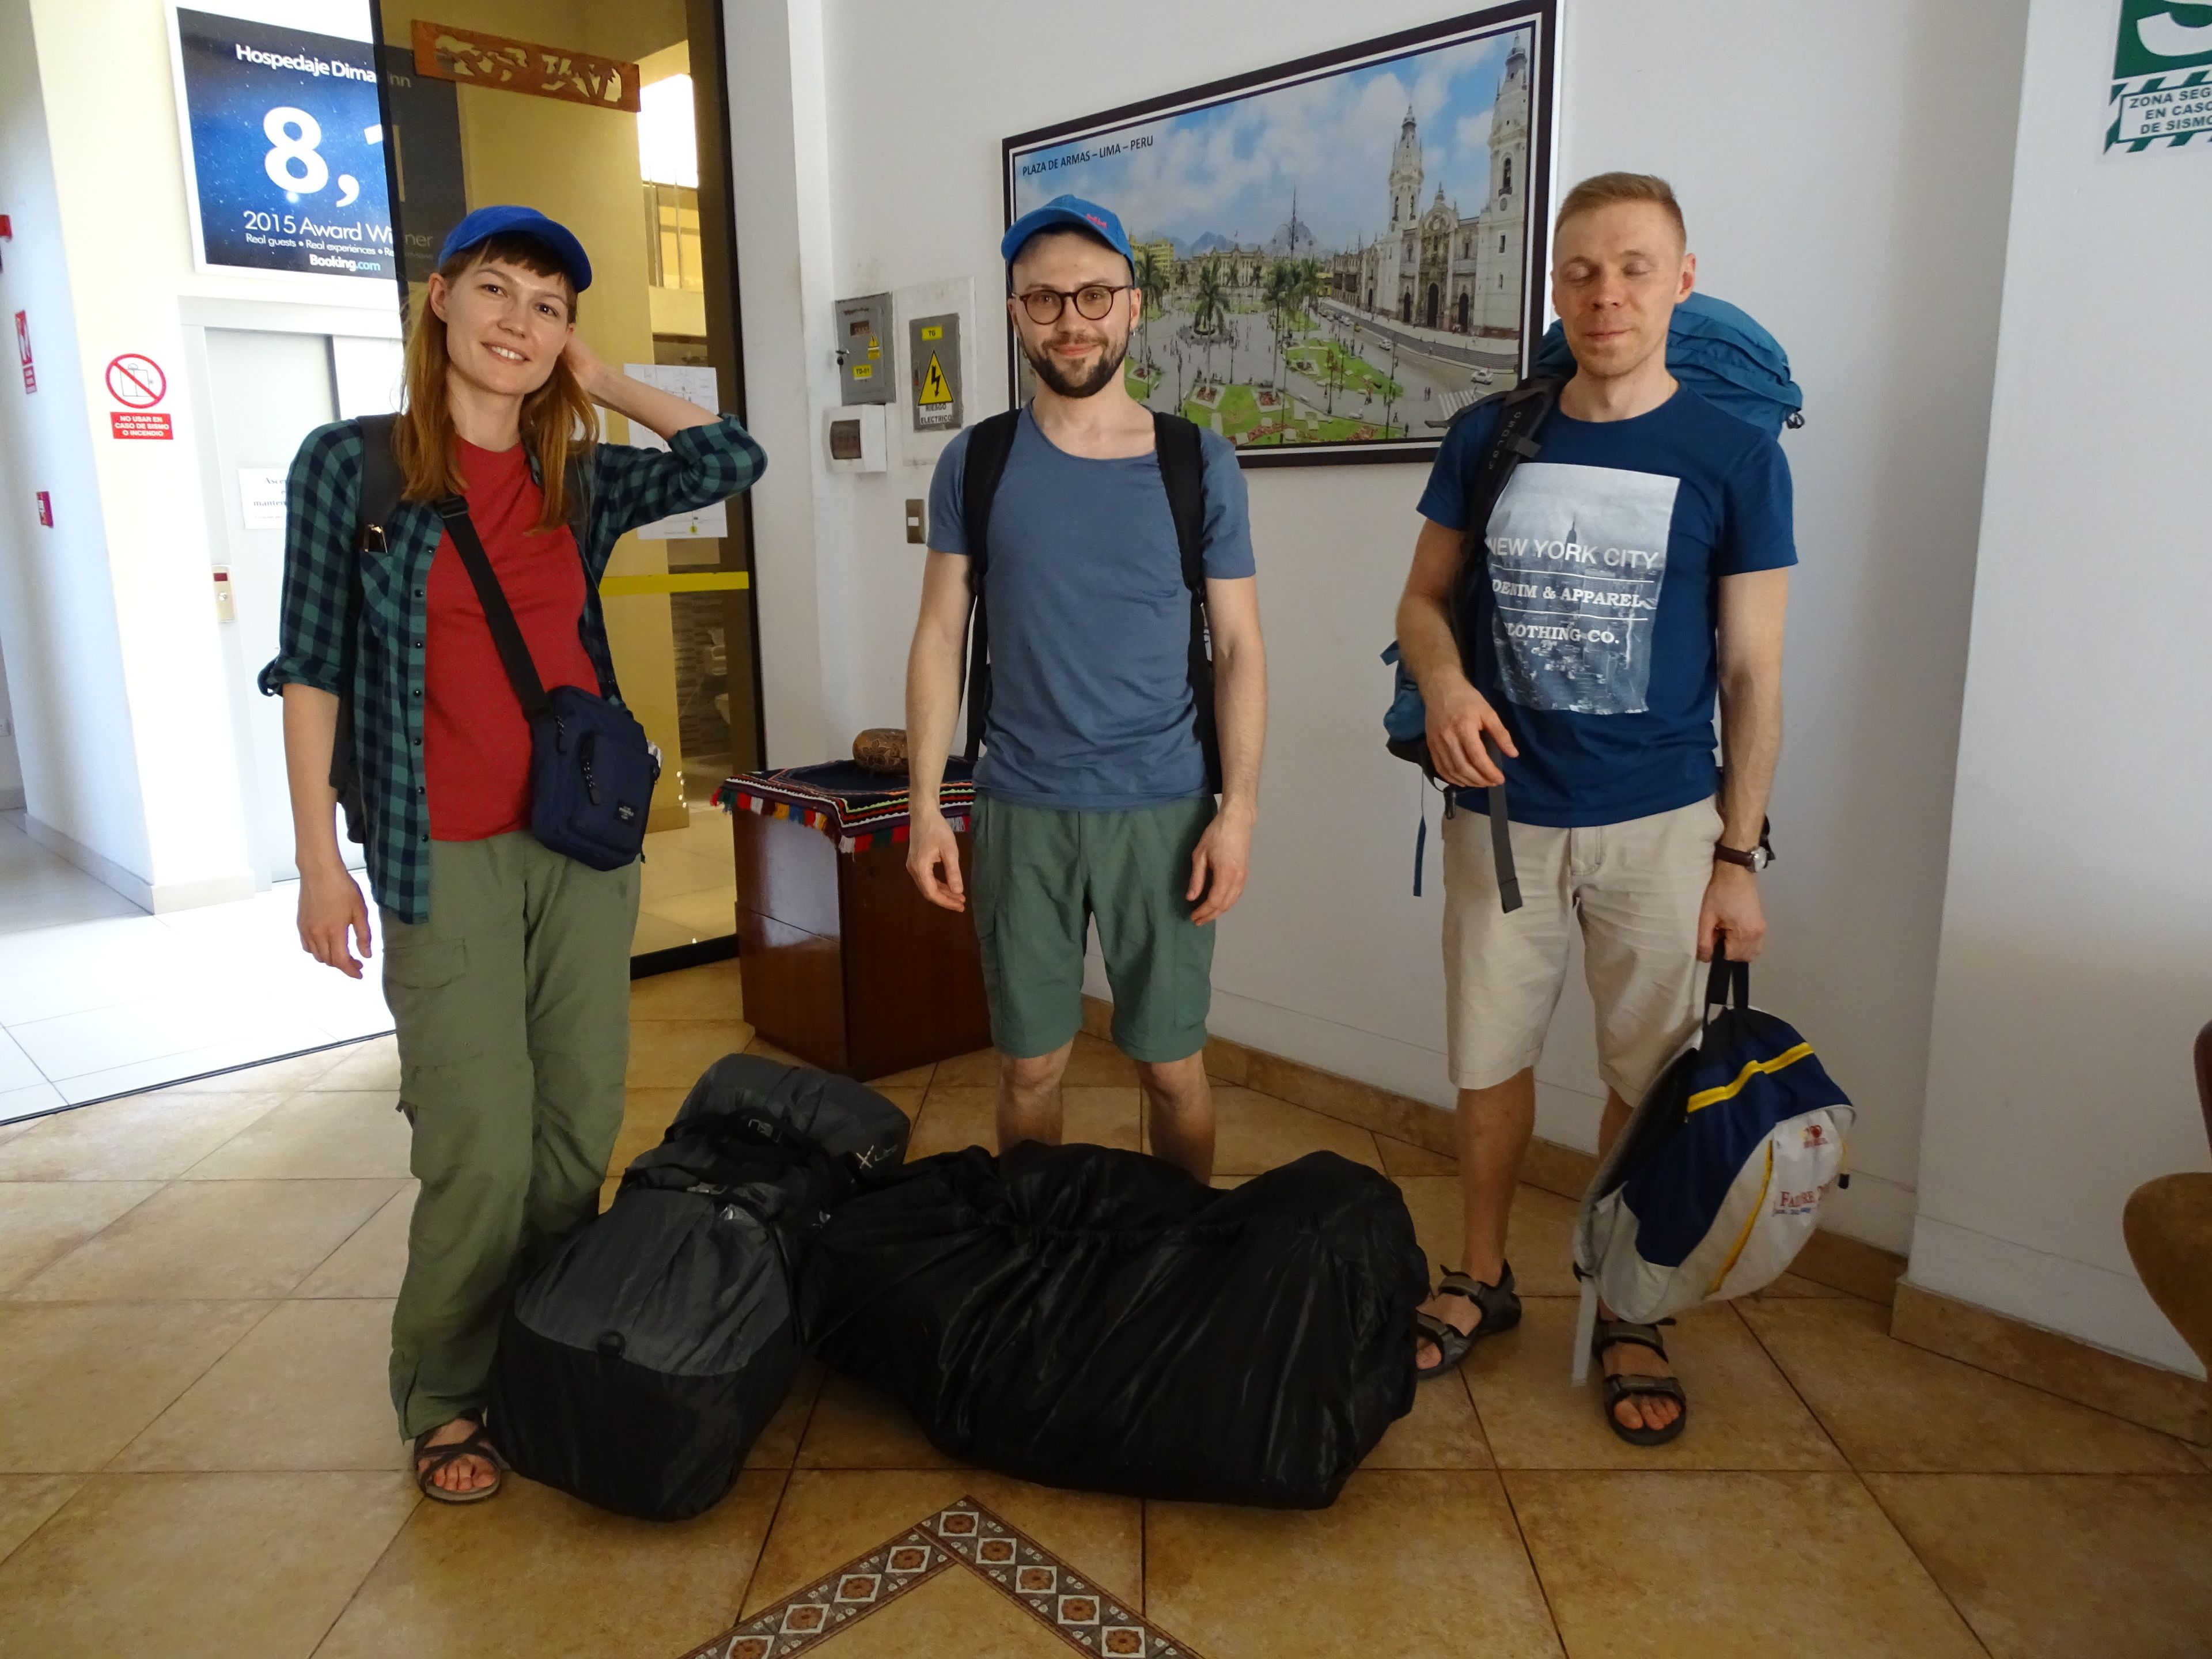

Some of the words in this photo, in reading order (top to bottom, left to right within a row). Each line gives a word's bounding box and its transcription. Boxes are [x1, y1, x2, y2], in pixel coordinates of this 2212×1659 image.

[236, 43, 330, 77] Hospedaje
[331, 60, 377, 84] Dima
[2128, 93, 2174, 109] ZONA
[2145, 108, 2166, 120] EN
[2172, 101, 2212, 116] CASO
[2140, 122, 2161, 134] DE
[1022, 163, 1046, 176] PLAZA
[1048, 159, 1058, 171] DE
[1060, 150, 1090, 168] ARMAS
[1099, 143, 1121, 158] LIMA
[1130, 135, 1153, 151] PERU
[243, 210, 297, 234] 2015
[300, 216, 362, 241] Award
[245, 233, 266, 244] Real
[268, 236, 297, 248] guests
[306, 239, 325, 250] Real
[327, 243, 376, 256] experiences
[309, 253, 381, 272] Booking.com
[925, 403, 946, 412] RIESGO
[921, 415, 952, 424] ELECTRICO
[1486, 537, 1529, 556] NEW
[1533, 539, 1599, 565] YORK
[1604, 547, 1659, 570] CITY
[1492, 579, 1538, 599] DENIM
[1543, 586, 1556, 600] &
[1560, 588, 1644, 608] APPAREL
[1587, 629, 1620, 644] CO.
